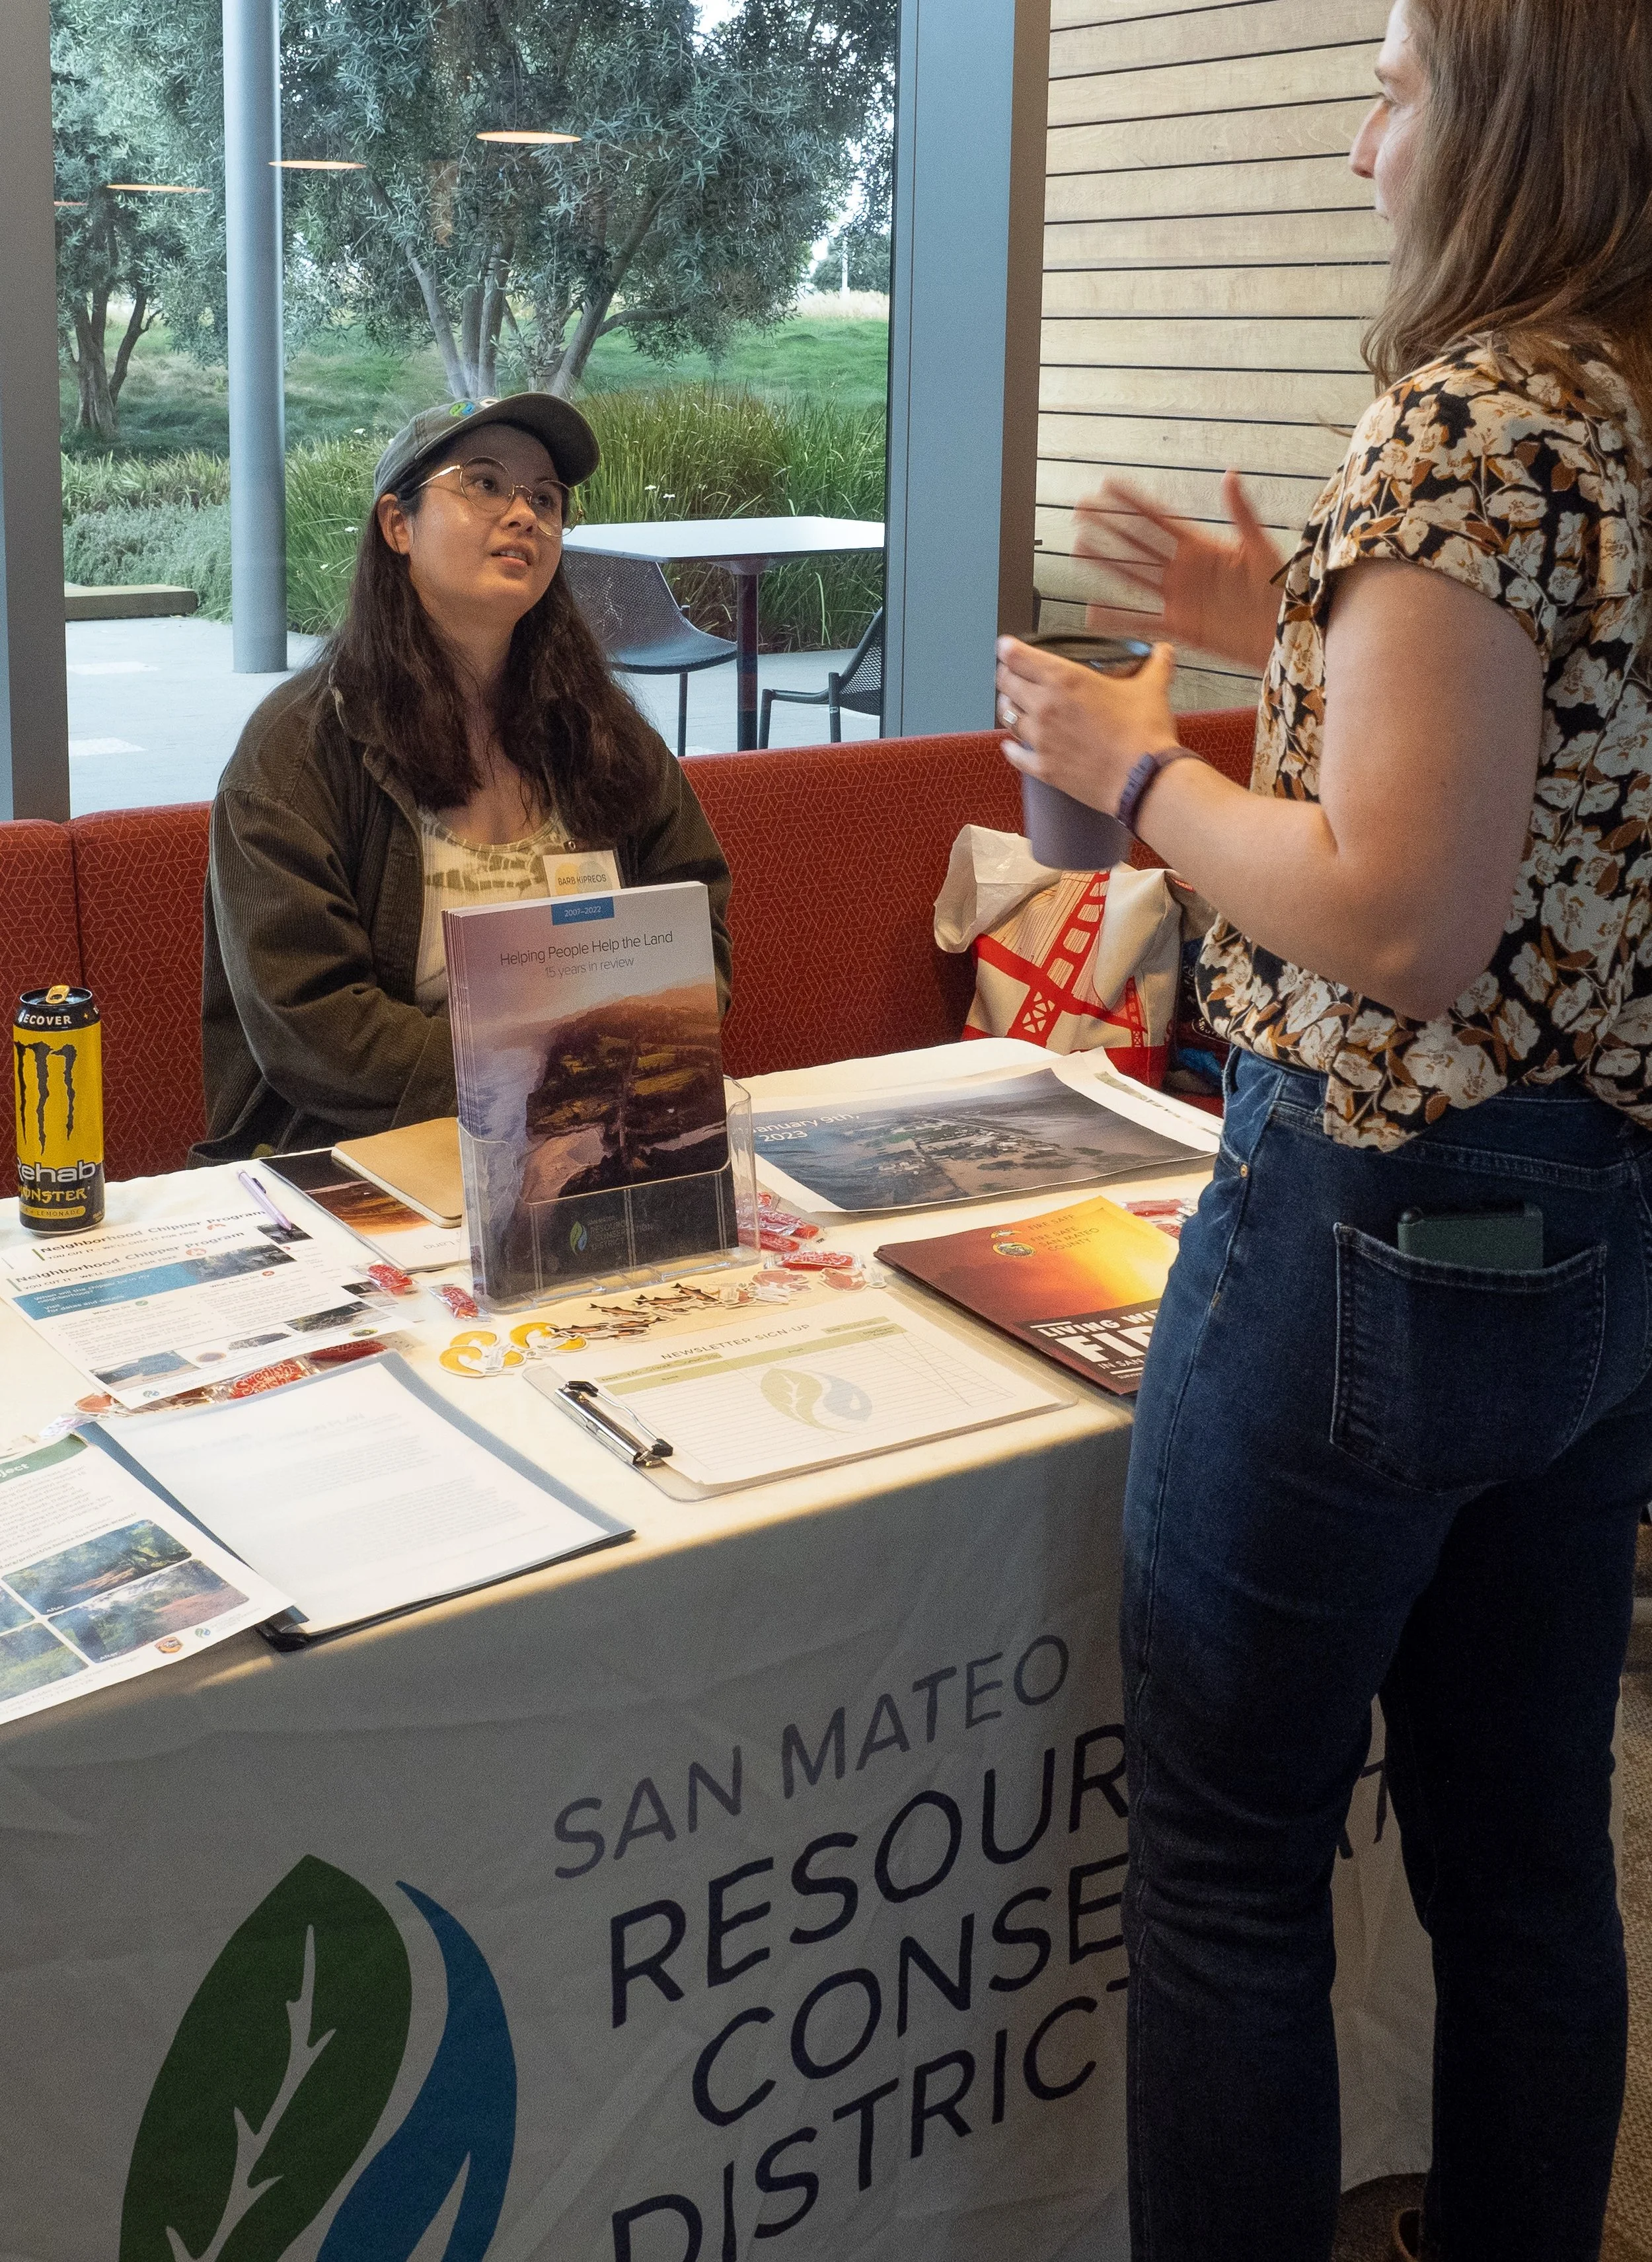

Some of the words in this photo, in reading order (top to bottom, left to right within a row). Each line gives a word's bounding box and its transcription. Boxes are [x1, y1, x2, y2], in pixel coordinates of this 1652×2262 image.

[558, 877, 576, 886] BARB
[577, 874, 607, 884] KIPREOS
[500, 950, 545, 966] Helping
[548, 944, 589, 959] People
[592, 939, 619, 953] Help
[622, 936, 640, 949] the
[644, 931, 673, 946] Land
[545, 966, 556, 978] 15
[559, 965, 586, 979] years
[588, 961, 597, 971] in
[601, 957, 634, 970] review
[753, 1119, 817, 1133] anuary
[760, 1131, 807, 1142] 2023
[40, 1230, 143, 1253] Neighborhood
[148, 1221, 201, 1233] Chipper
[207, 1211, 265, 1223] Program
[1028, 1221, 1049, 1231] FIRE
[1030, 1234, 1051, 1242] FIRE
[1053, 1226, 1079, 1236] SAFE
[1039, 1238, 1061, 1247] SAN
[1064, 1228, 1100, 1242] MATEO
[17, 1259, 120, 1282] Neighborhood
[125, 1246, 180, 1260] Chipper
[185, 1232, 244, 1248] Program
[1047, 1238, 1091, 1252] COUNTY
[1037, 1320, 1121, 1338] LIVING
[1121, 1309, 1159, 1324] WI
[661, 1337, 751, 1359] NEWSLETTER
[755, 1324, 810, 1341] SIGN-UP
[235, 1363, 292, 1390] Swedish
[0, 1462, 30, 1478] ject
[552, 1747, 743, 1879] SAN
[781, 1634, 1070, 1799] MATEO
[609, 1723, 1130, 2028] RESOUR
[611, 1976, 1129, 2262] DISTRIC
